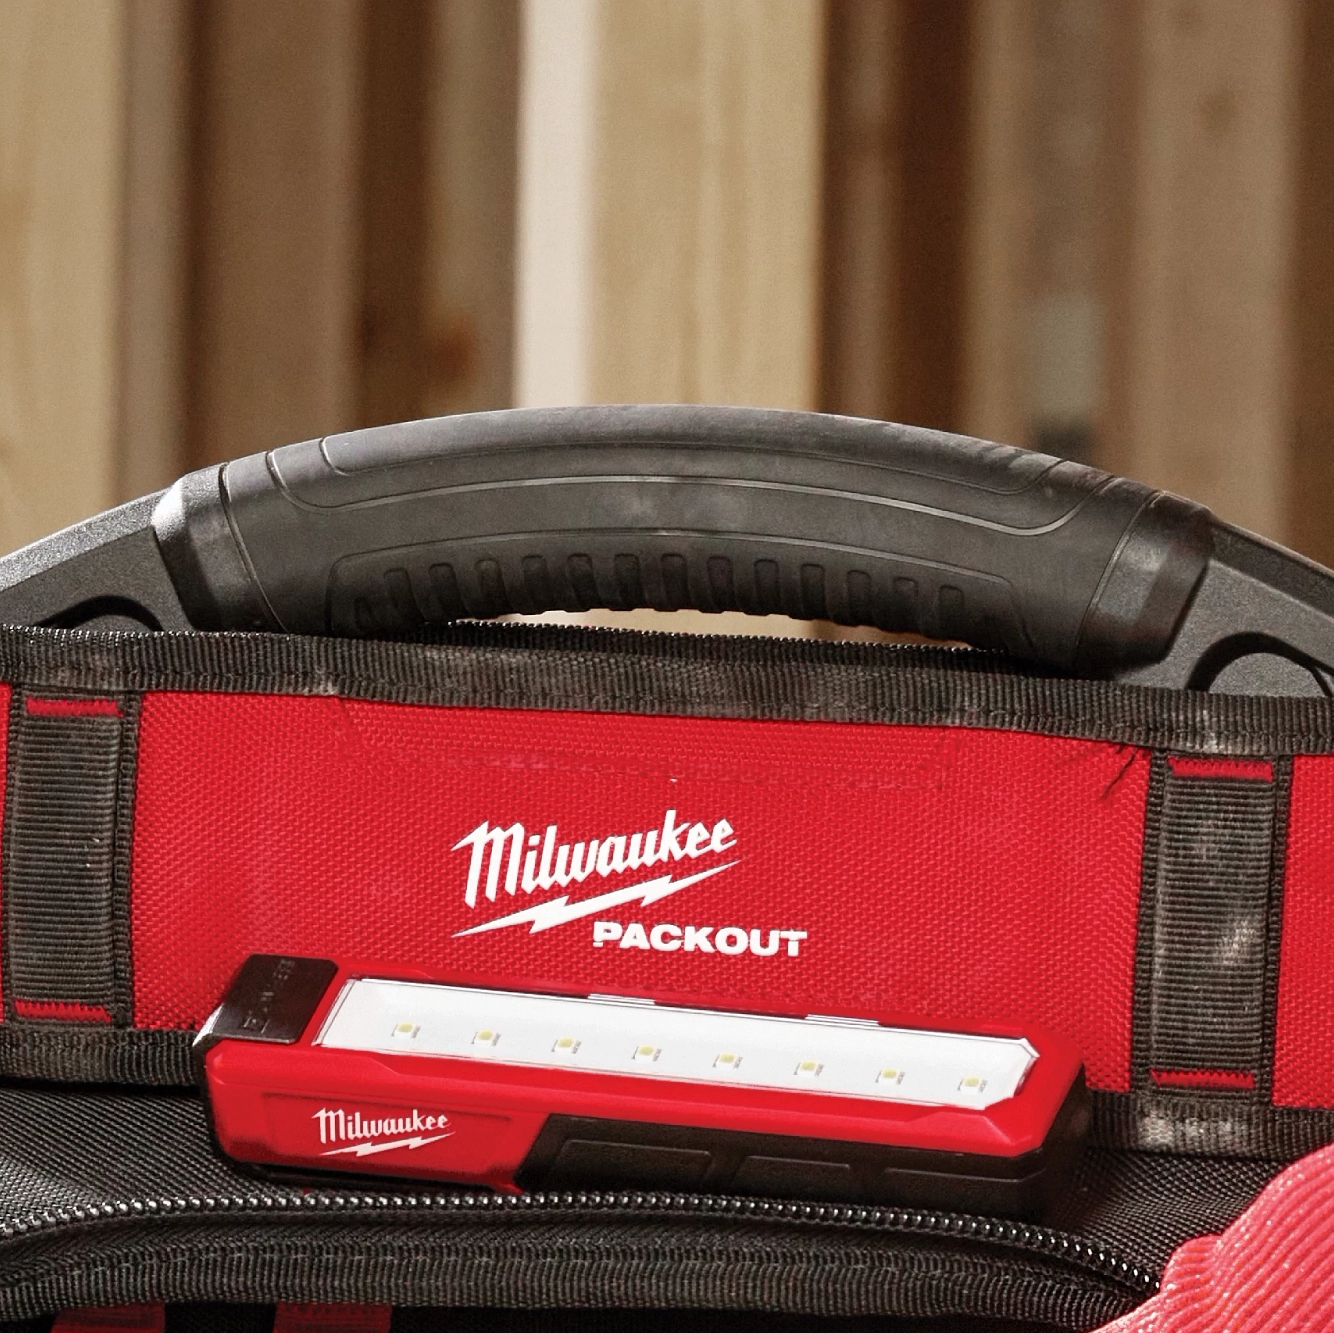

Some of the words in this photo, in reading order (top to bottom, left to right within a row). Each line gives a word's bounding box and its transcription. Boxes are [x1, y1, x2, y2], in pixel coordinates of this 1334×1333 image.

[451, 809, 739, 910] Milwaukee
[592, 920, 808, 957] PACKOUT
[311, 1107, 452, 1144] Milwaukee
